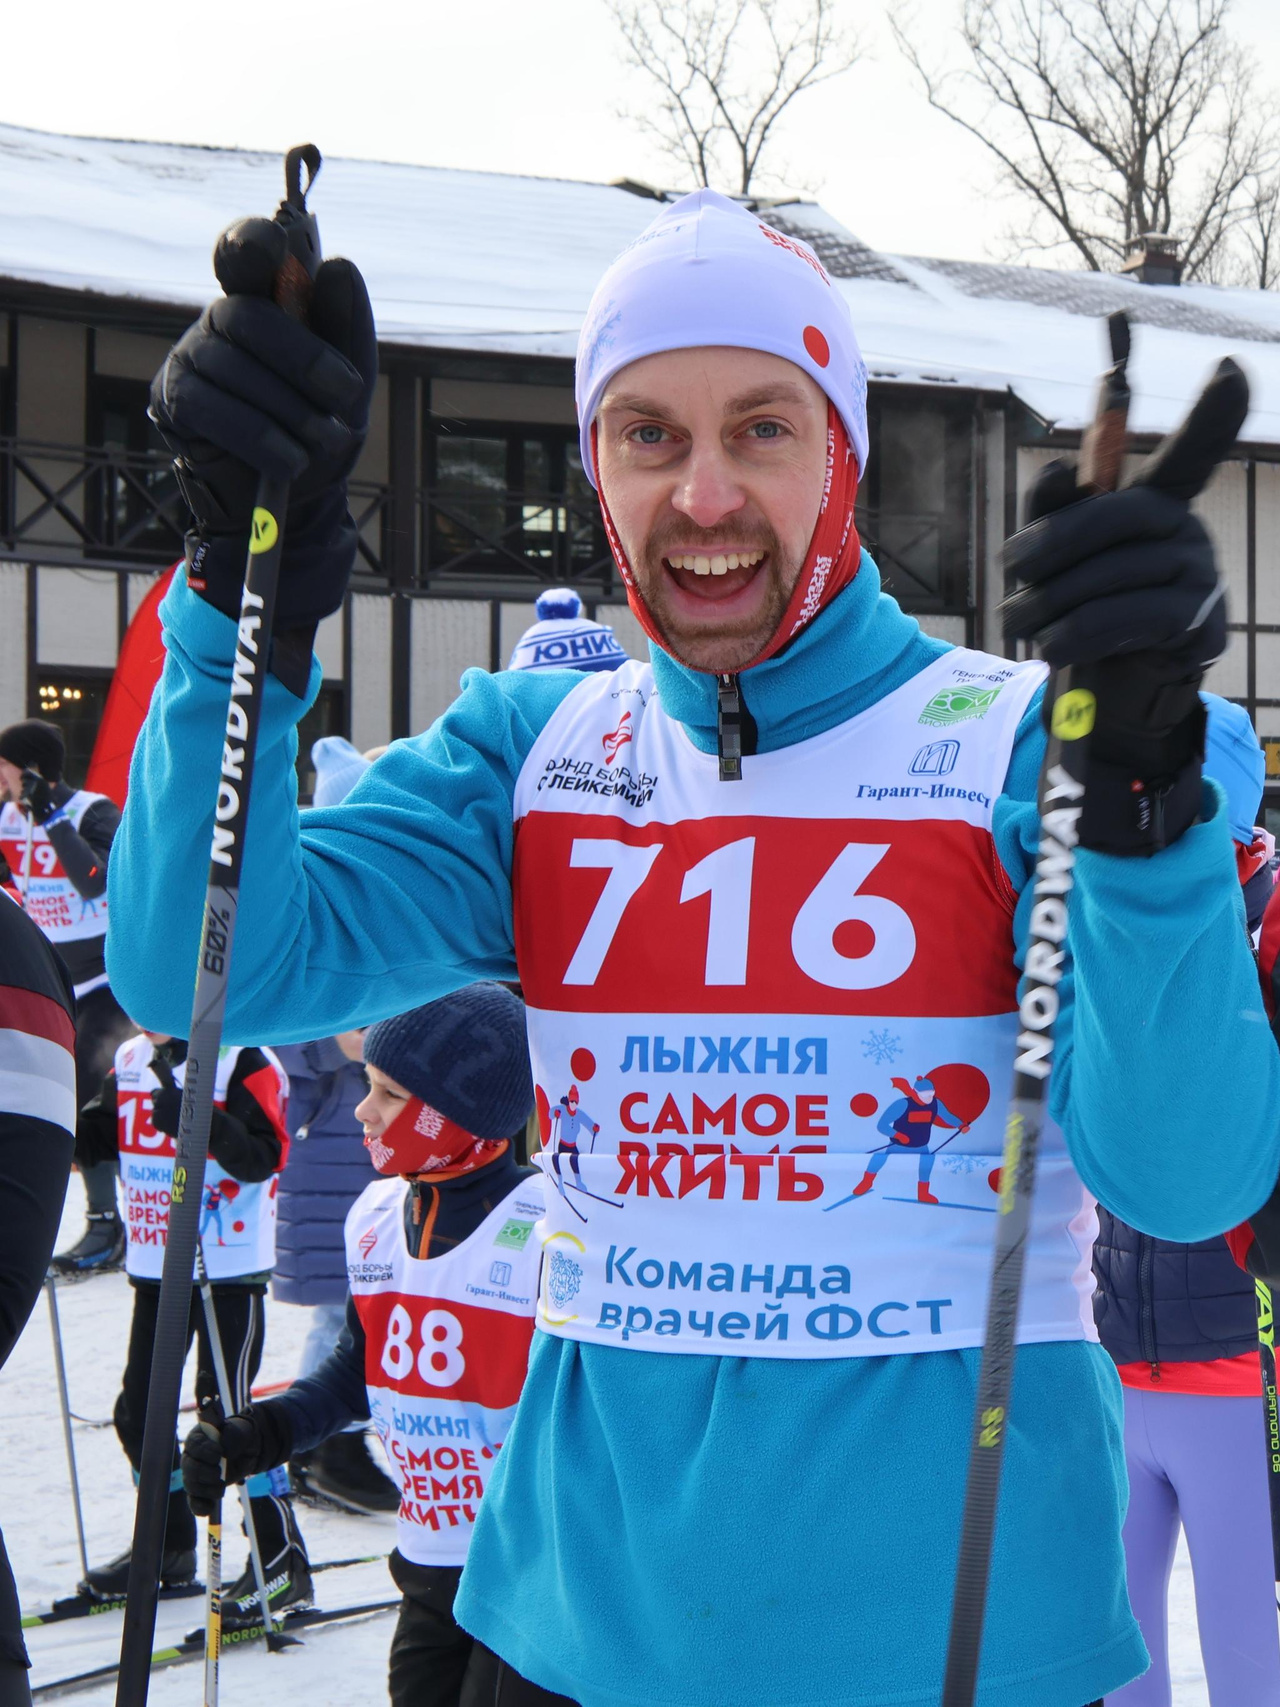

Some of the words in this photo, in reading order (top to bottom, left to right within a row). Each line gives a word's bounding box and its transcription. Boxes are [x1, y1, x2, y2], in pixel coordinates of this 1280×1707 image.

[210, 583, 265, 868] NORDWAY
[856, 783, 992, 809] Гарант-Инвест
[560, 837, 917, 991] 716
[1013, 763, 1085, 1081] NORDWAY
[203, 905, 231, 977] 60%
[619, 1035, 829, 1076] ЛЫЖНЯ
[619, 1091, 830, 1138] САМОЕ
[126, 1164, 173, 1184] ЛЫЖН
[171, 1166, 188, 1204] RS
[613, 1153, 825, 1203] ЖИТЬ
[128, 1186, 172, 1207] САМО
[128, 1206, 170, 1226] ВРЕМ
[129, 1226, 168, 1247] ЖИТ
[604, 1244, 851, 1300] Команда
[465, 1283, 531, 1306] Гарант-Инвест
[595, 1301, 789, 1342] врачей
[804, 1298, 953, 1342] ФСТ
[381, 1303, 466, 1388] 88
[1266, 1385, 1280, 1451] DIAMOND
[391, 1440, 480, 1472] СМОЕ
[398, 1465, 485, 1501] РЕМЯ
